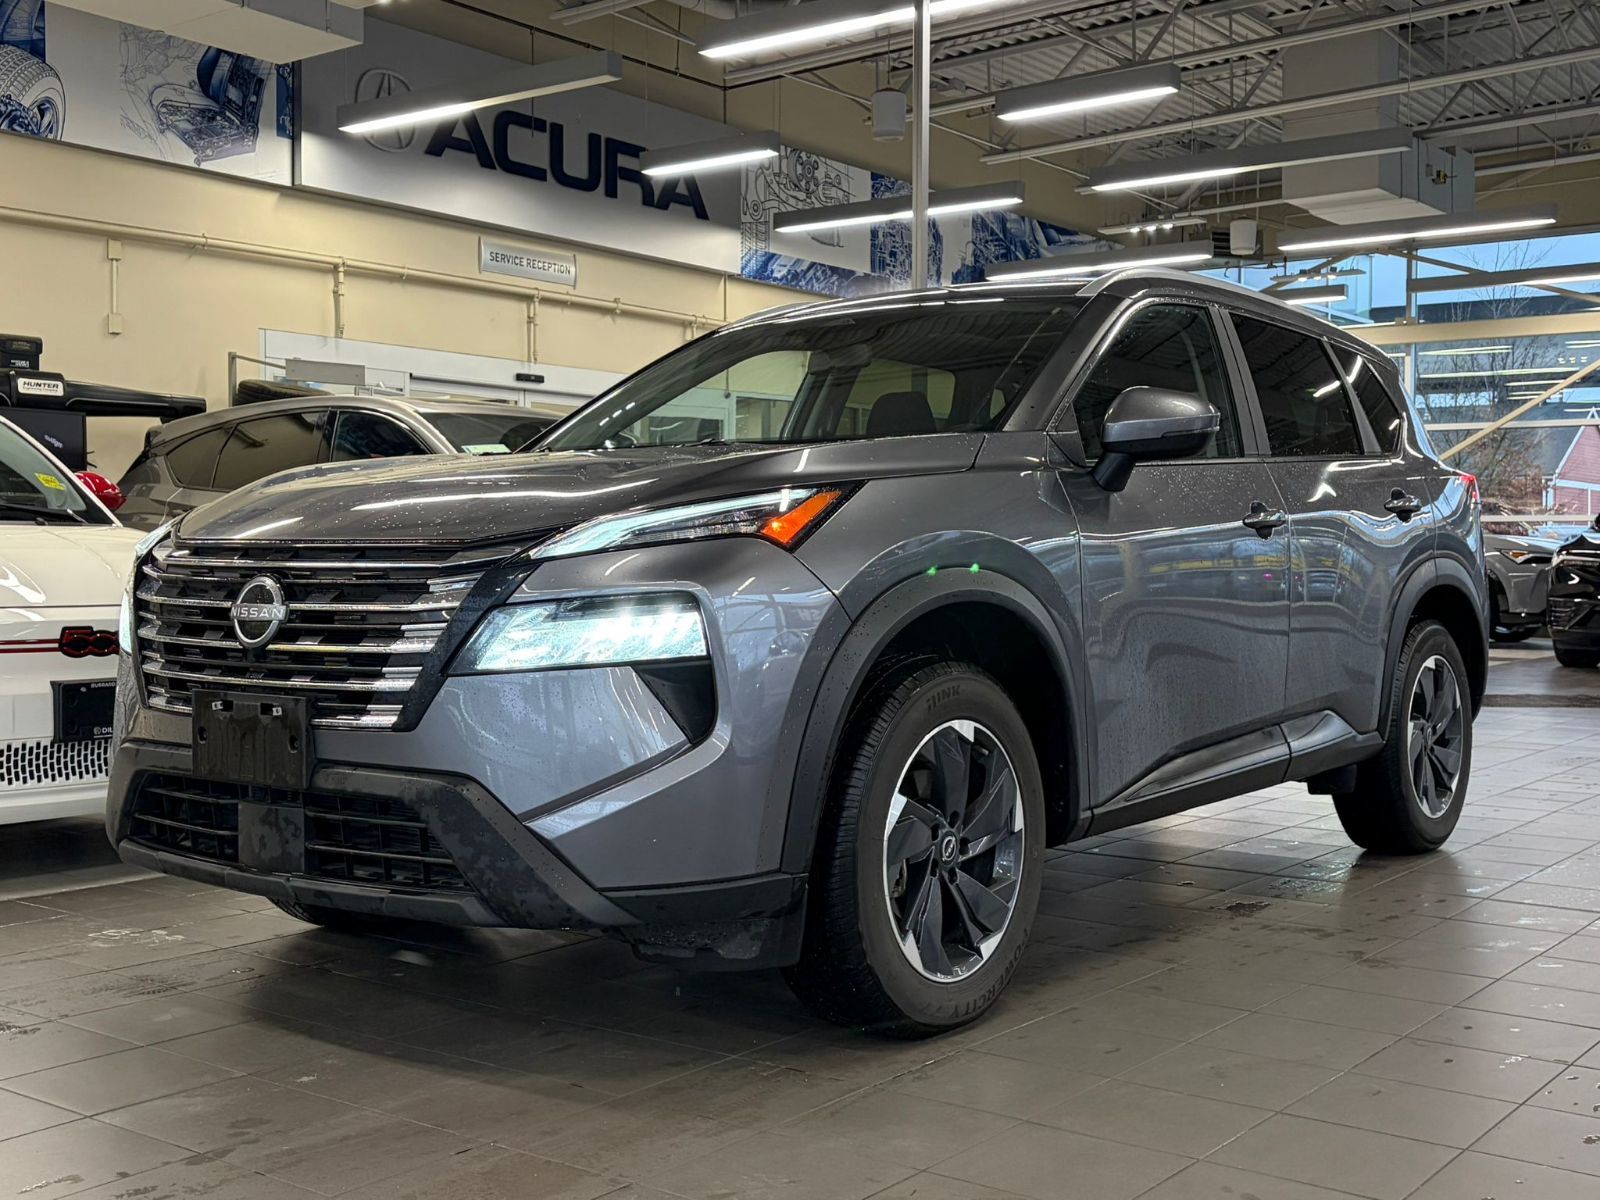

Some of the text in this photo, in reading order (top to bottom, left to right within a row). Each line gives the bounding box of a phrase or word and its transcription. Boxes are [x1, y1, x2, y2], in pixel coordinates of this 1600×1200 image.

[424, 109, 710, 221] ACURA
[489, 251, 571, 275] SERVICE RECEPTION
[23, 380, 59, 389] HUNTER
[231, 606, 284, 618] NISSAN
